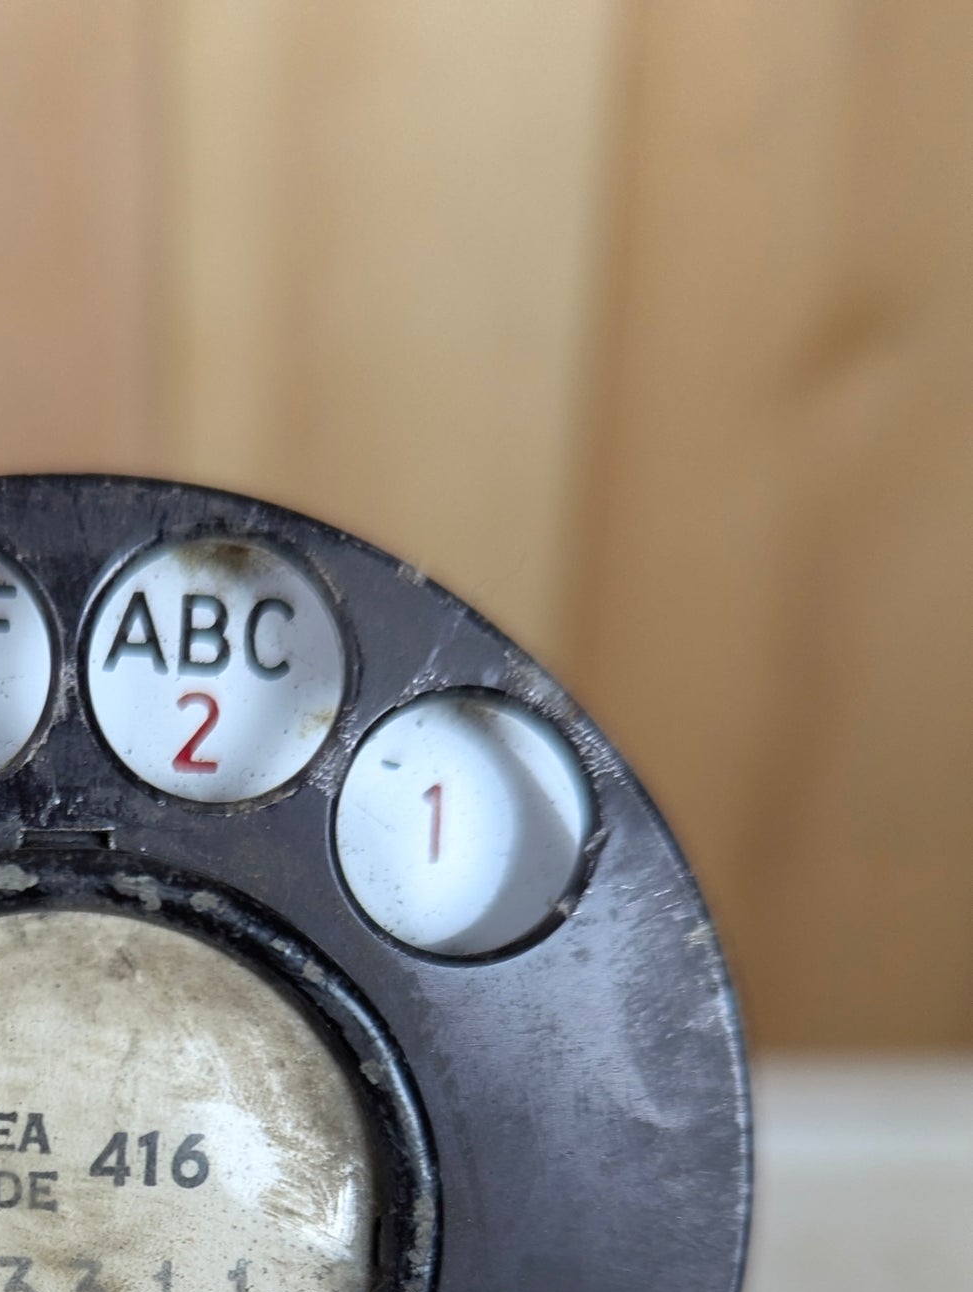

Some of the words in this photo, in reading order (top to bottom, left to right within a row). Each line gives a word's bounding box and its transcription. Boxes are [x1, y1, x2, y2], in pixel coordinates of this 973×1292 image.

[102, 590, 296, 681] ABC
[172, 691, 220, 774] 2
[422, 782, 443, 865] 1
[89, 1130, 211, 1190] 416
